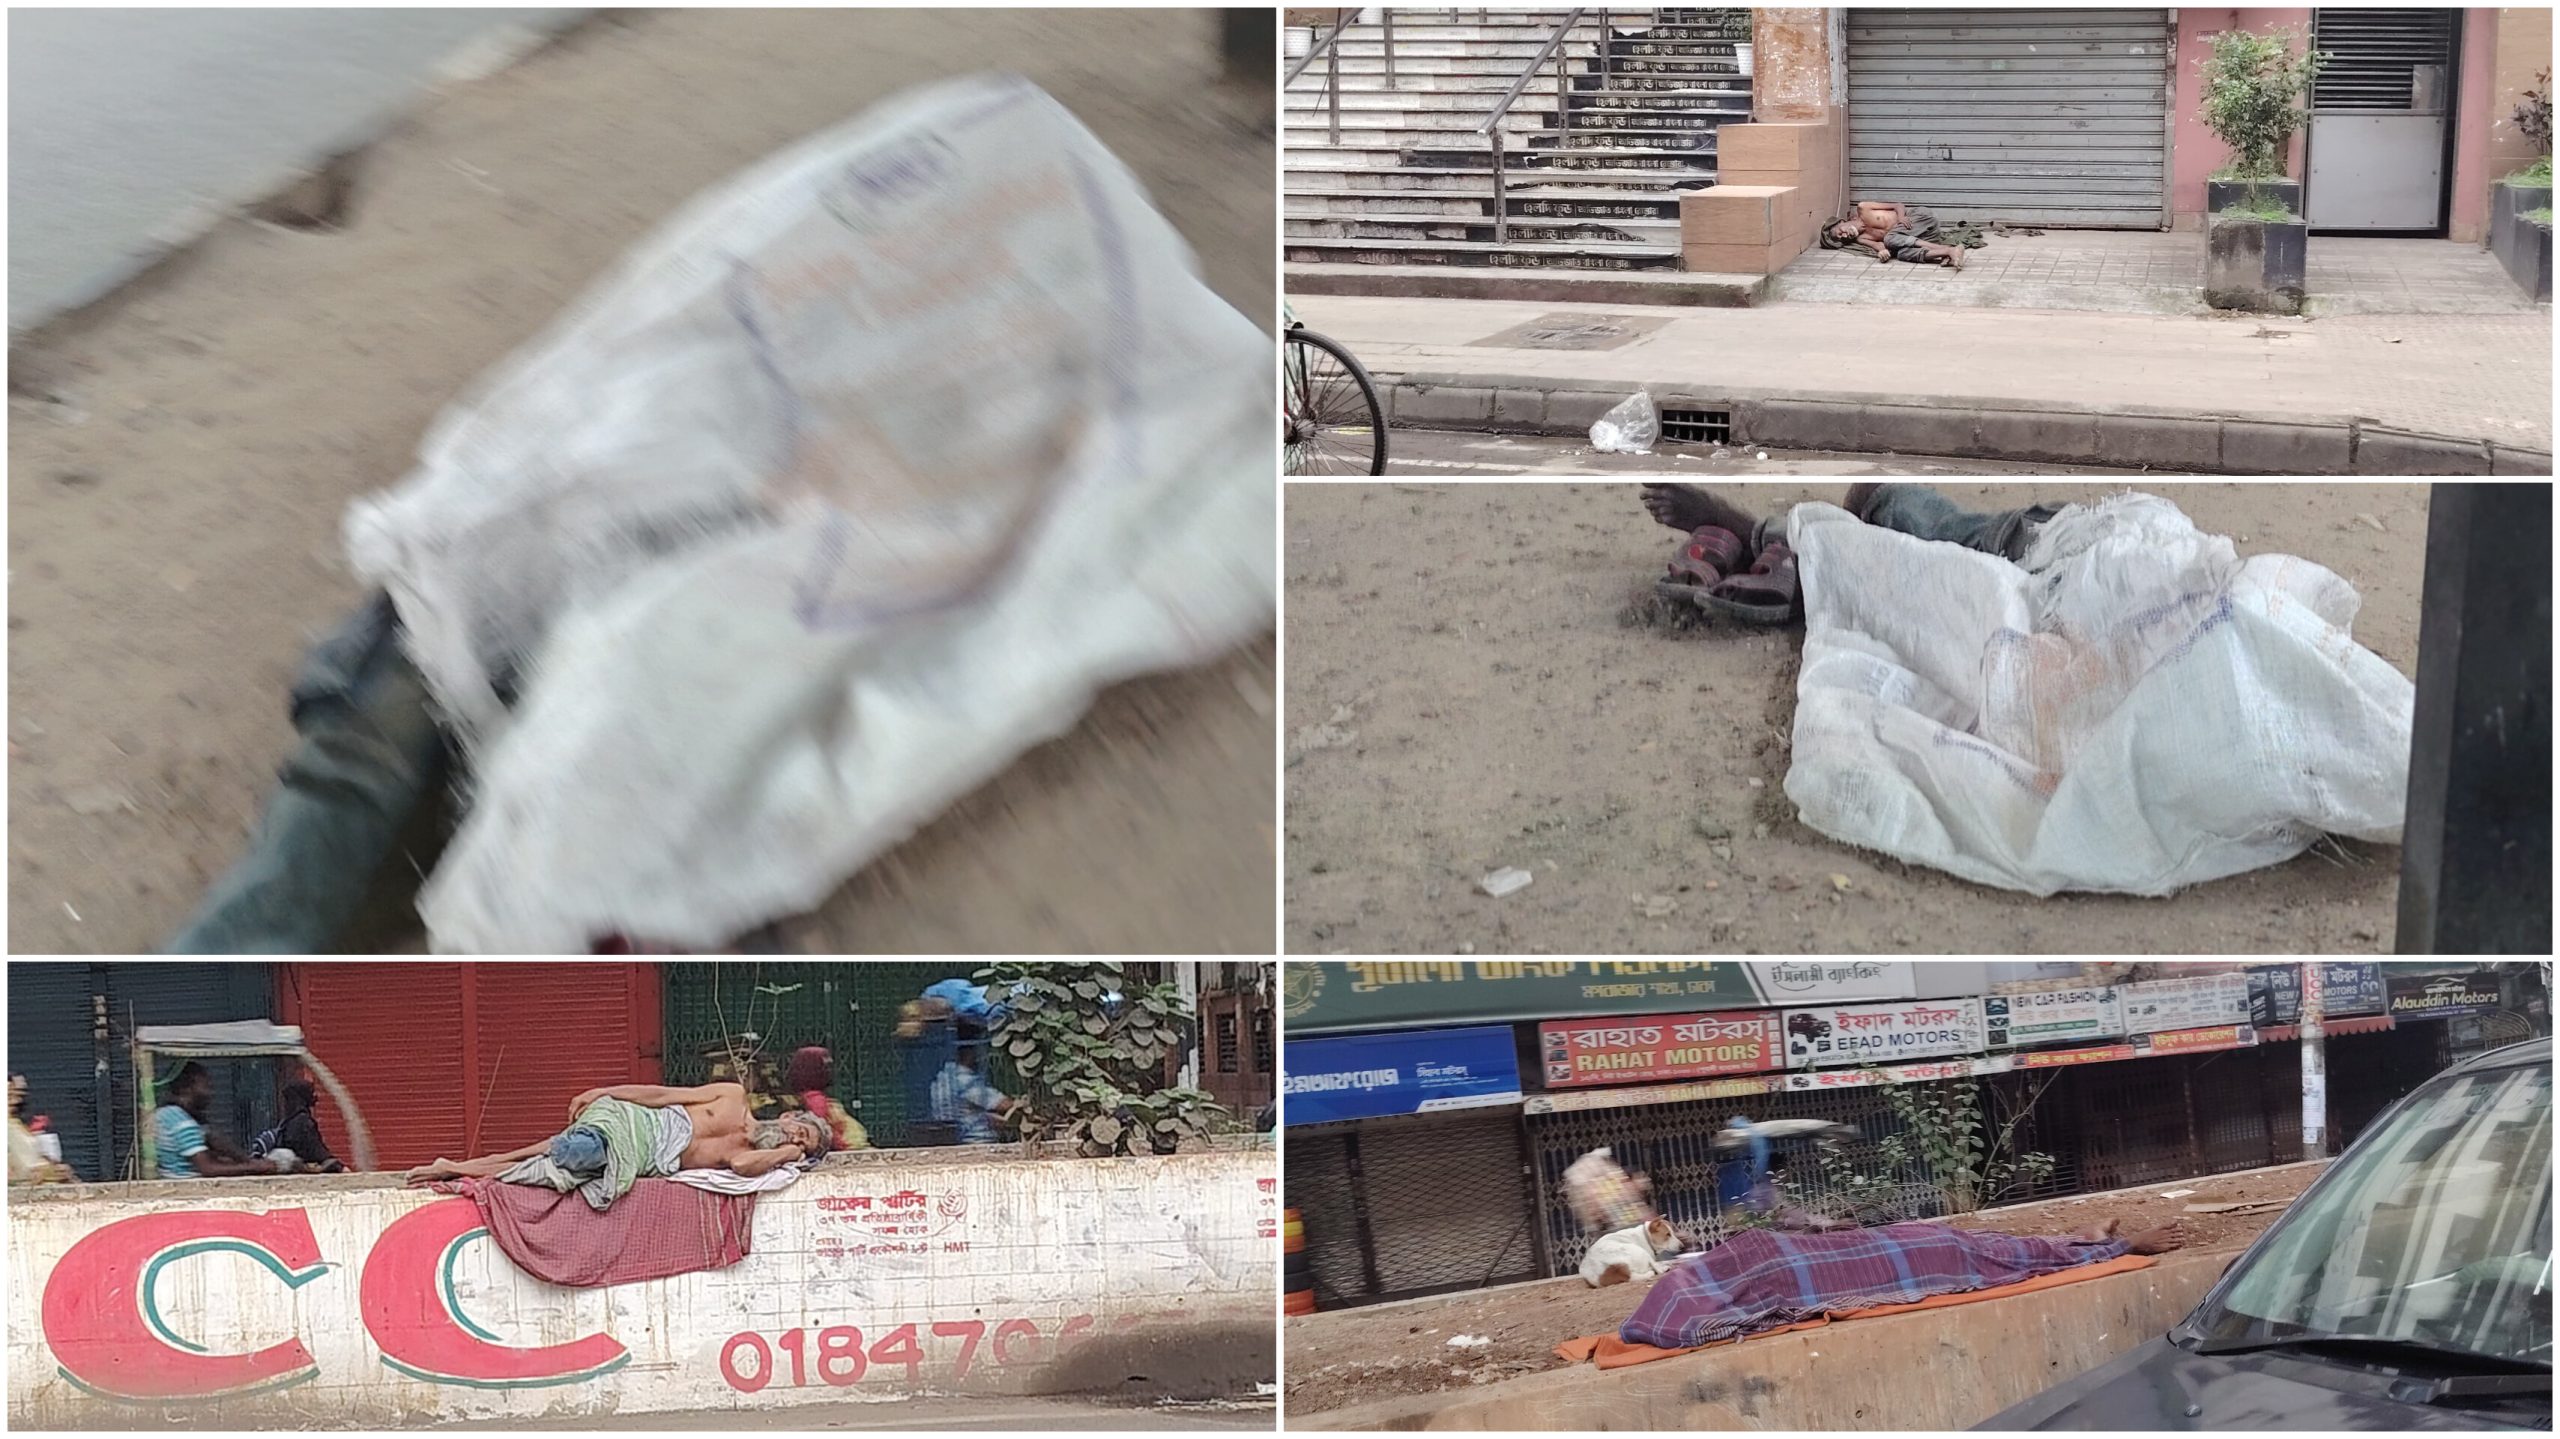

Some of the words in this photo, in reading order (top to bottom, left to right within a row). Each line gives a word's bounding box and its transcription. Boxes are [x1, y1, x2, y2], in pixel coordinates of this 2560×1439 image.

[2391, 993, 2449, 1011] Alauddin
[2451, 992, 2499, 1005] Motors
[1834, 1010, 1895, 1033] ইফাদ
[1570, 1025, 1663, 1053] রাহাত
[1837, 1035, 1890, 1051] EFAD
[1889, 1030, 1961, 1047] MOTORS
[1576, 1051, 1656, 1073] RAHAT
[1665, 1043, 1761, 1069] MOTORS
[1669, 1086, 1712, 1100] RAHAT
[1714, 1081, 1767, 1097] MOTORS
[943, 1241, 972, 1253] HMT
